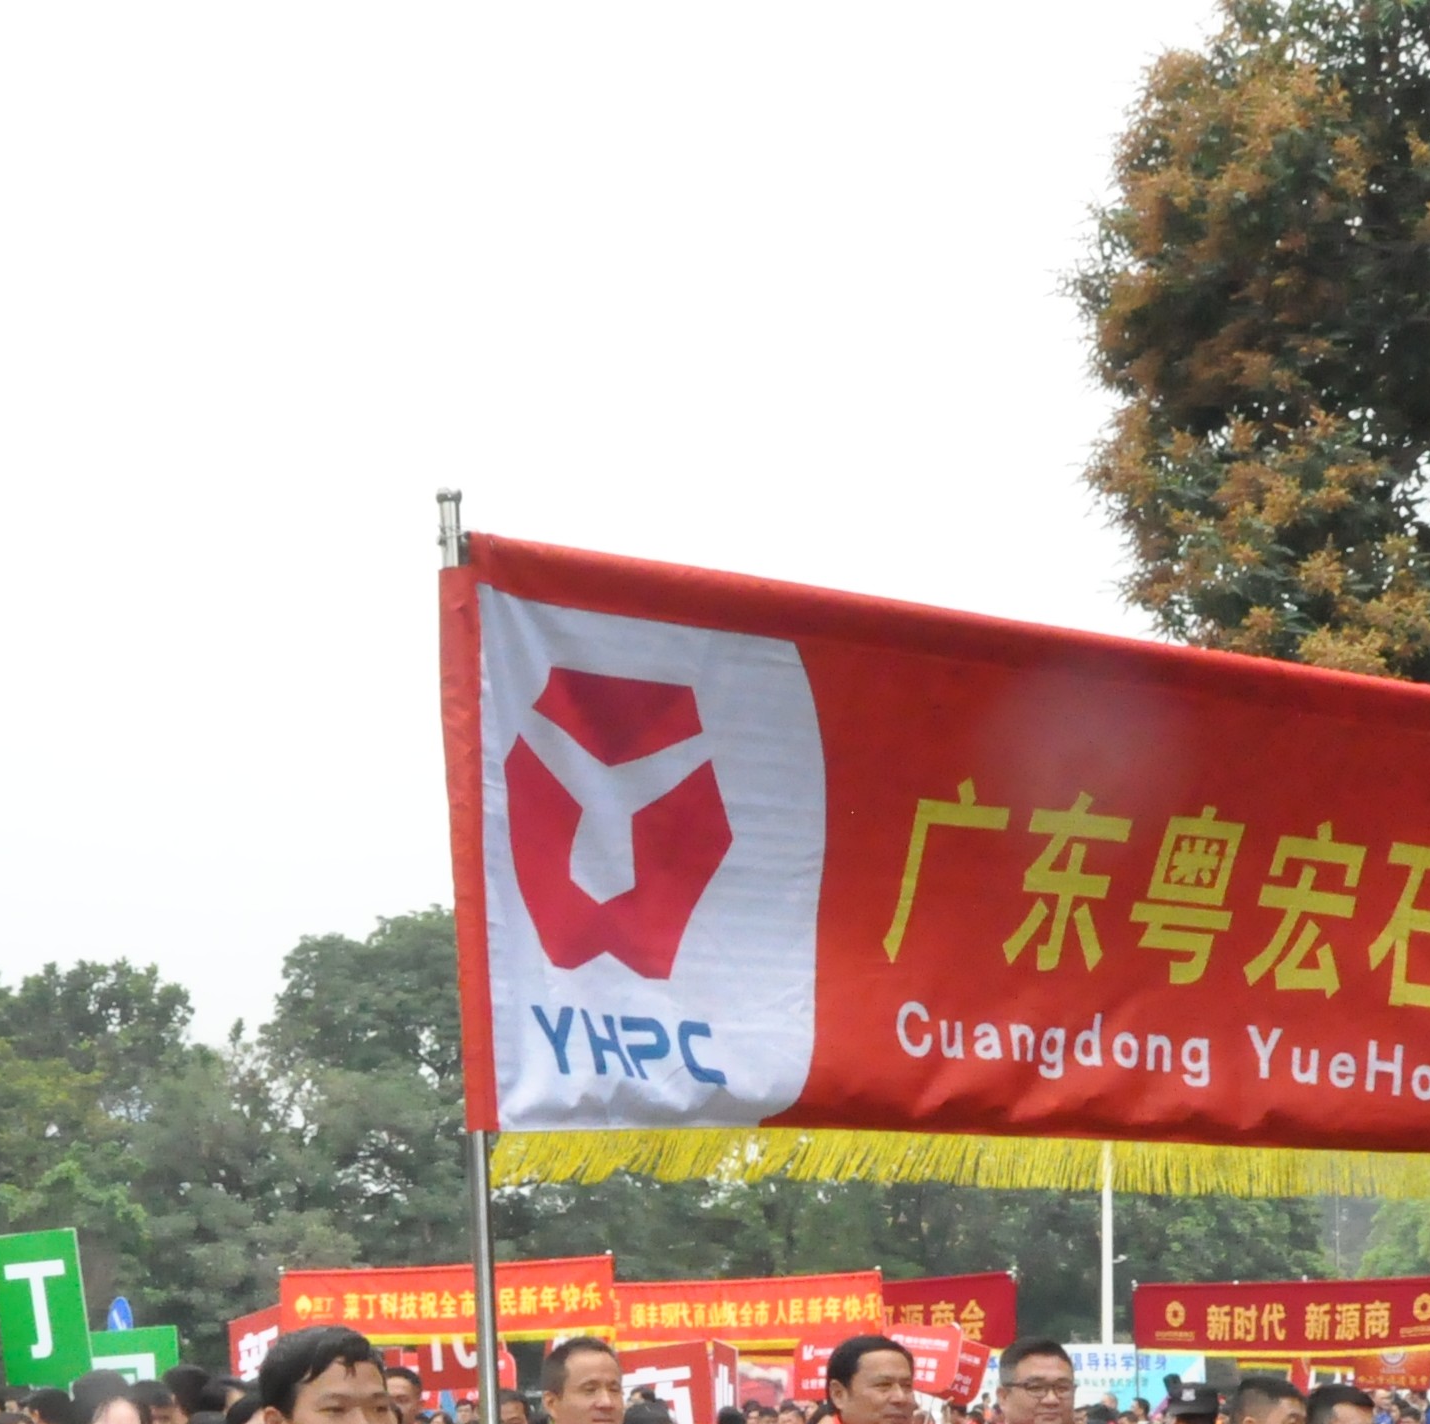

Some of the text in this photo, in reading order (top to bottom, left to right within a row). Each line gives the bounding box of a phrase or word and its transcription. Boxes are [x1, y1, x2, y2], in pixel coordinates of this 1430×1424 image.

[532, 1004, 727, 1086] YHPC
[895, 1000, 1211, 1088] Cuangdong
[342, 1280, 603, 1320] 菜丁科技祝全市民新年快乐
[1206, 1299, 1392, 1343] 新时代 新源商
